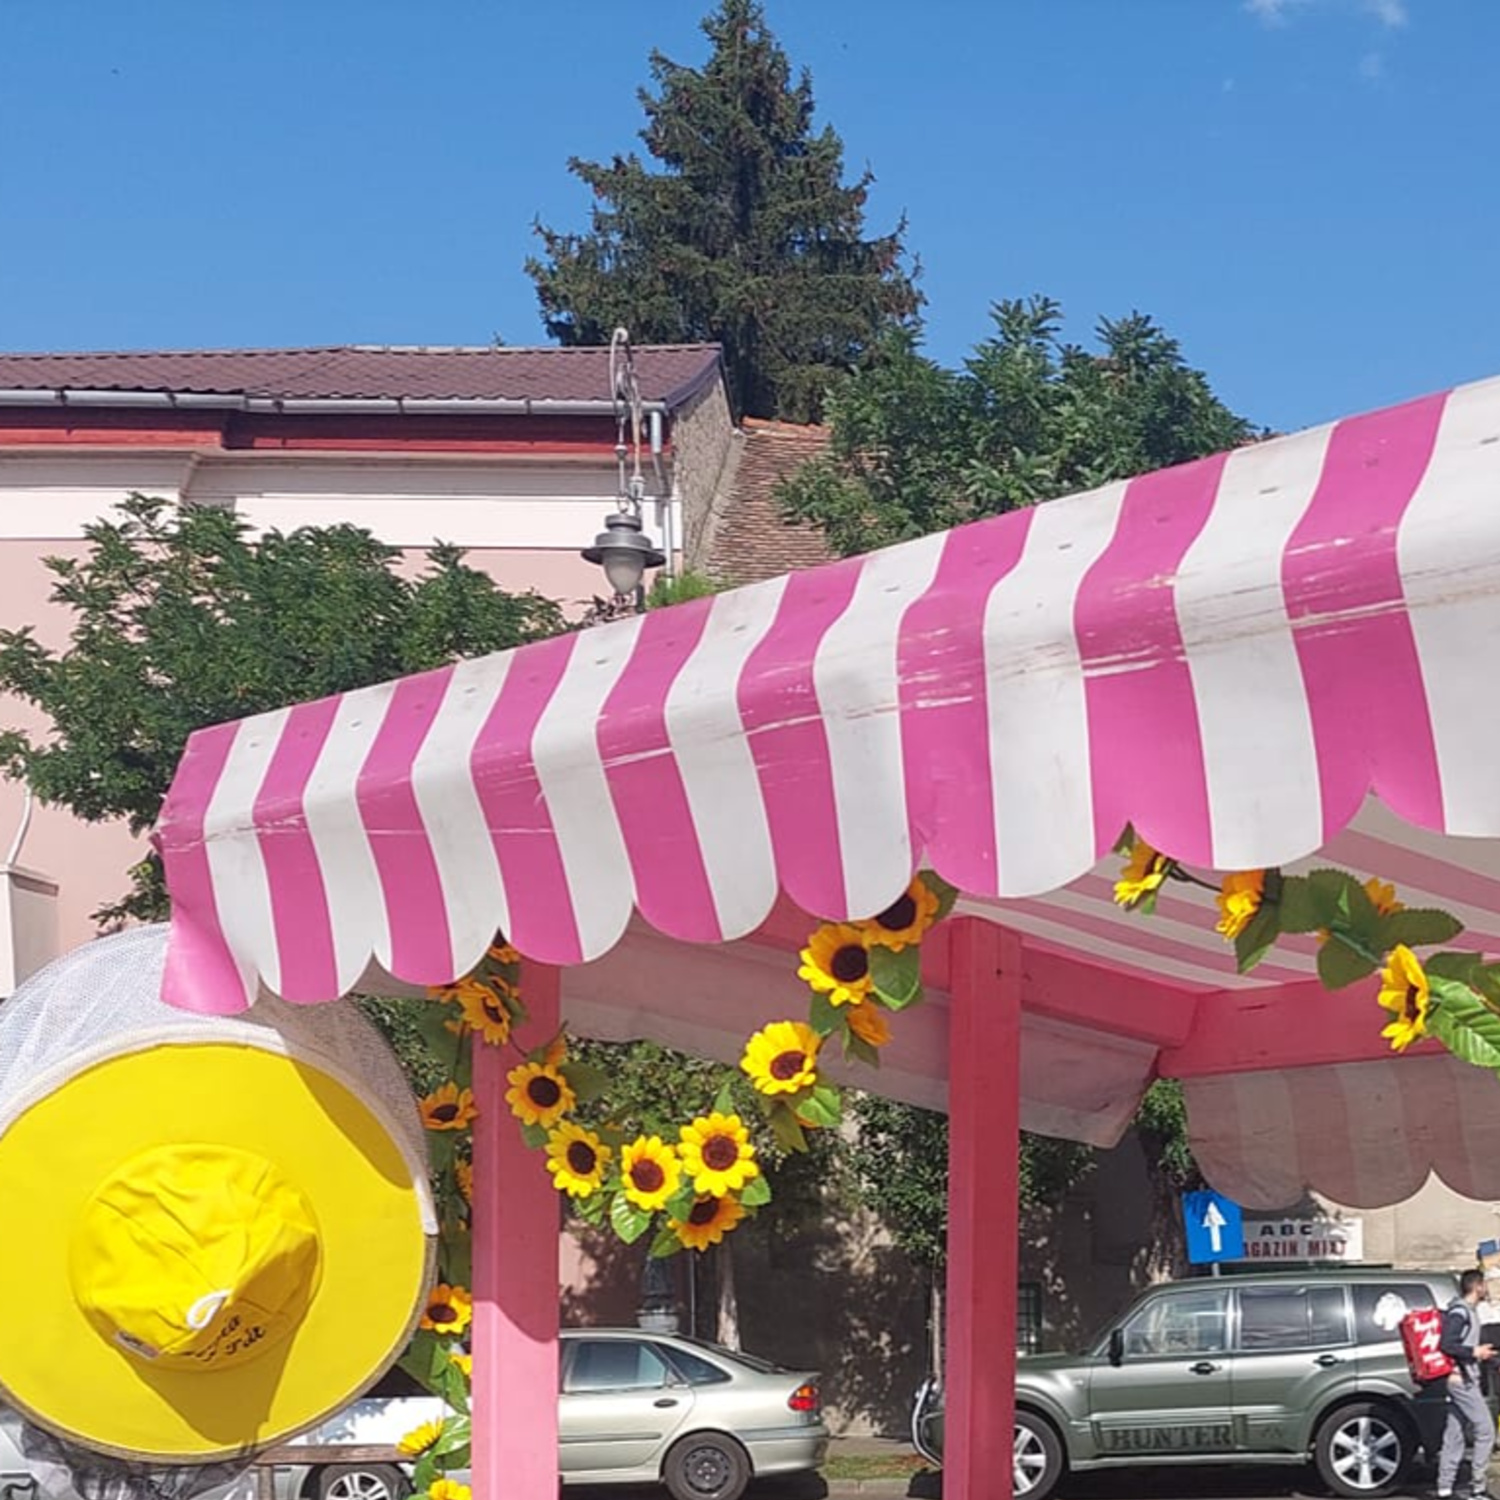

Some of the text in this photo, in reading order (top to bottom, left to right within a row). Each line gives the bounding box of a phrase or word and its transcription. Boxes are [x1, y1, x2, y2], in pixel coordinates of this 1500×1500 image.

[1260, 1224, 1313, 1237] ABC
[1243, 1241, 1298, 1257] AGAZIN
[1110, 1425, 1232, 1449] HUNTER
